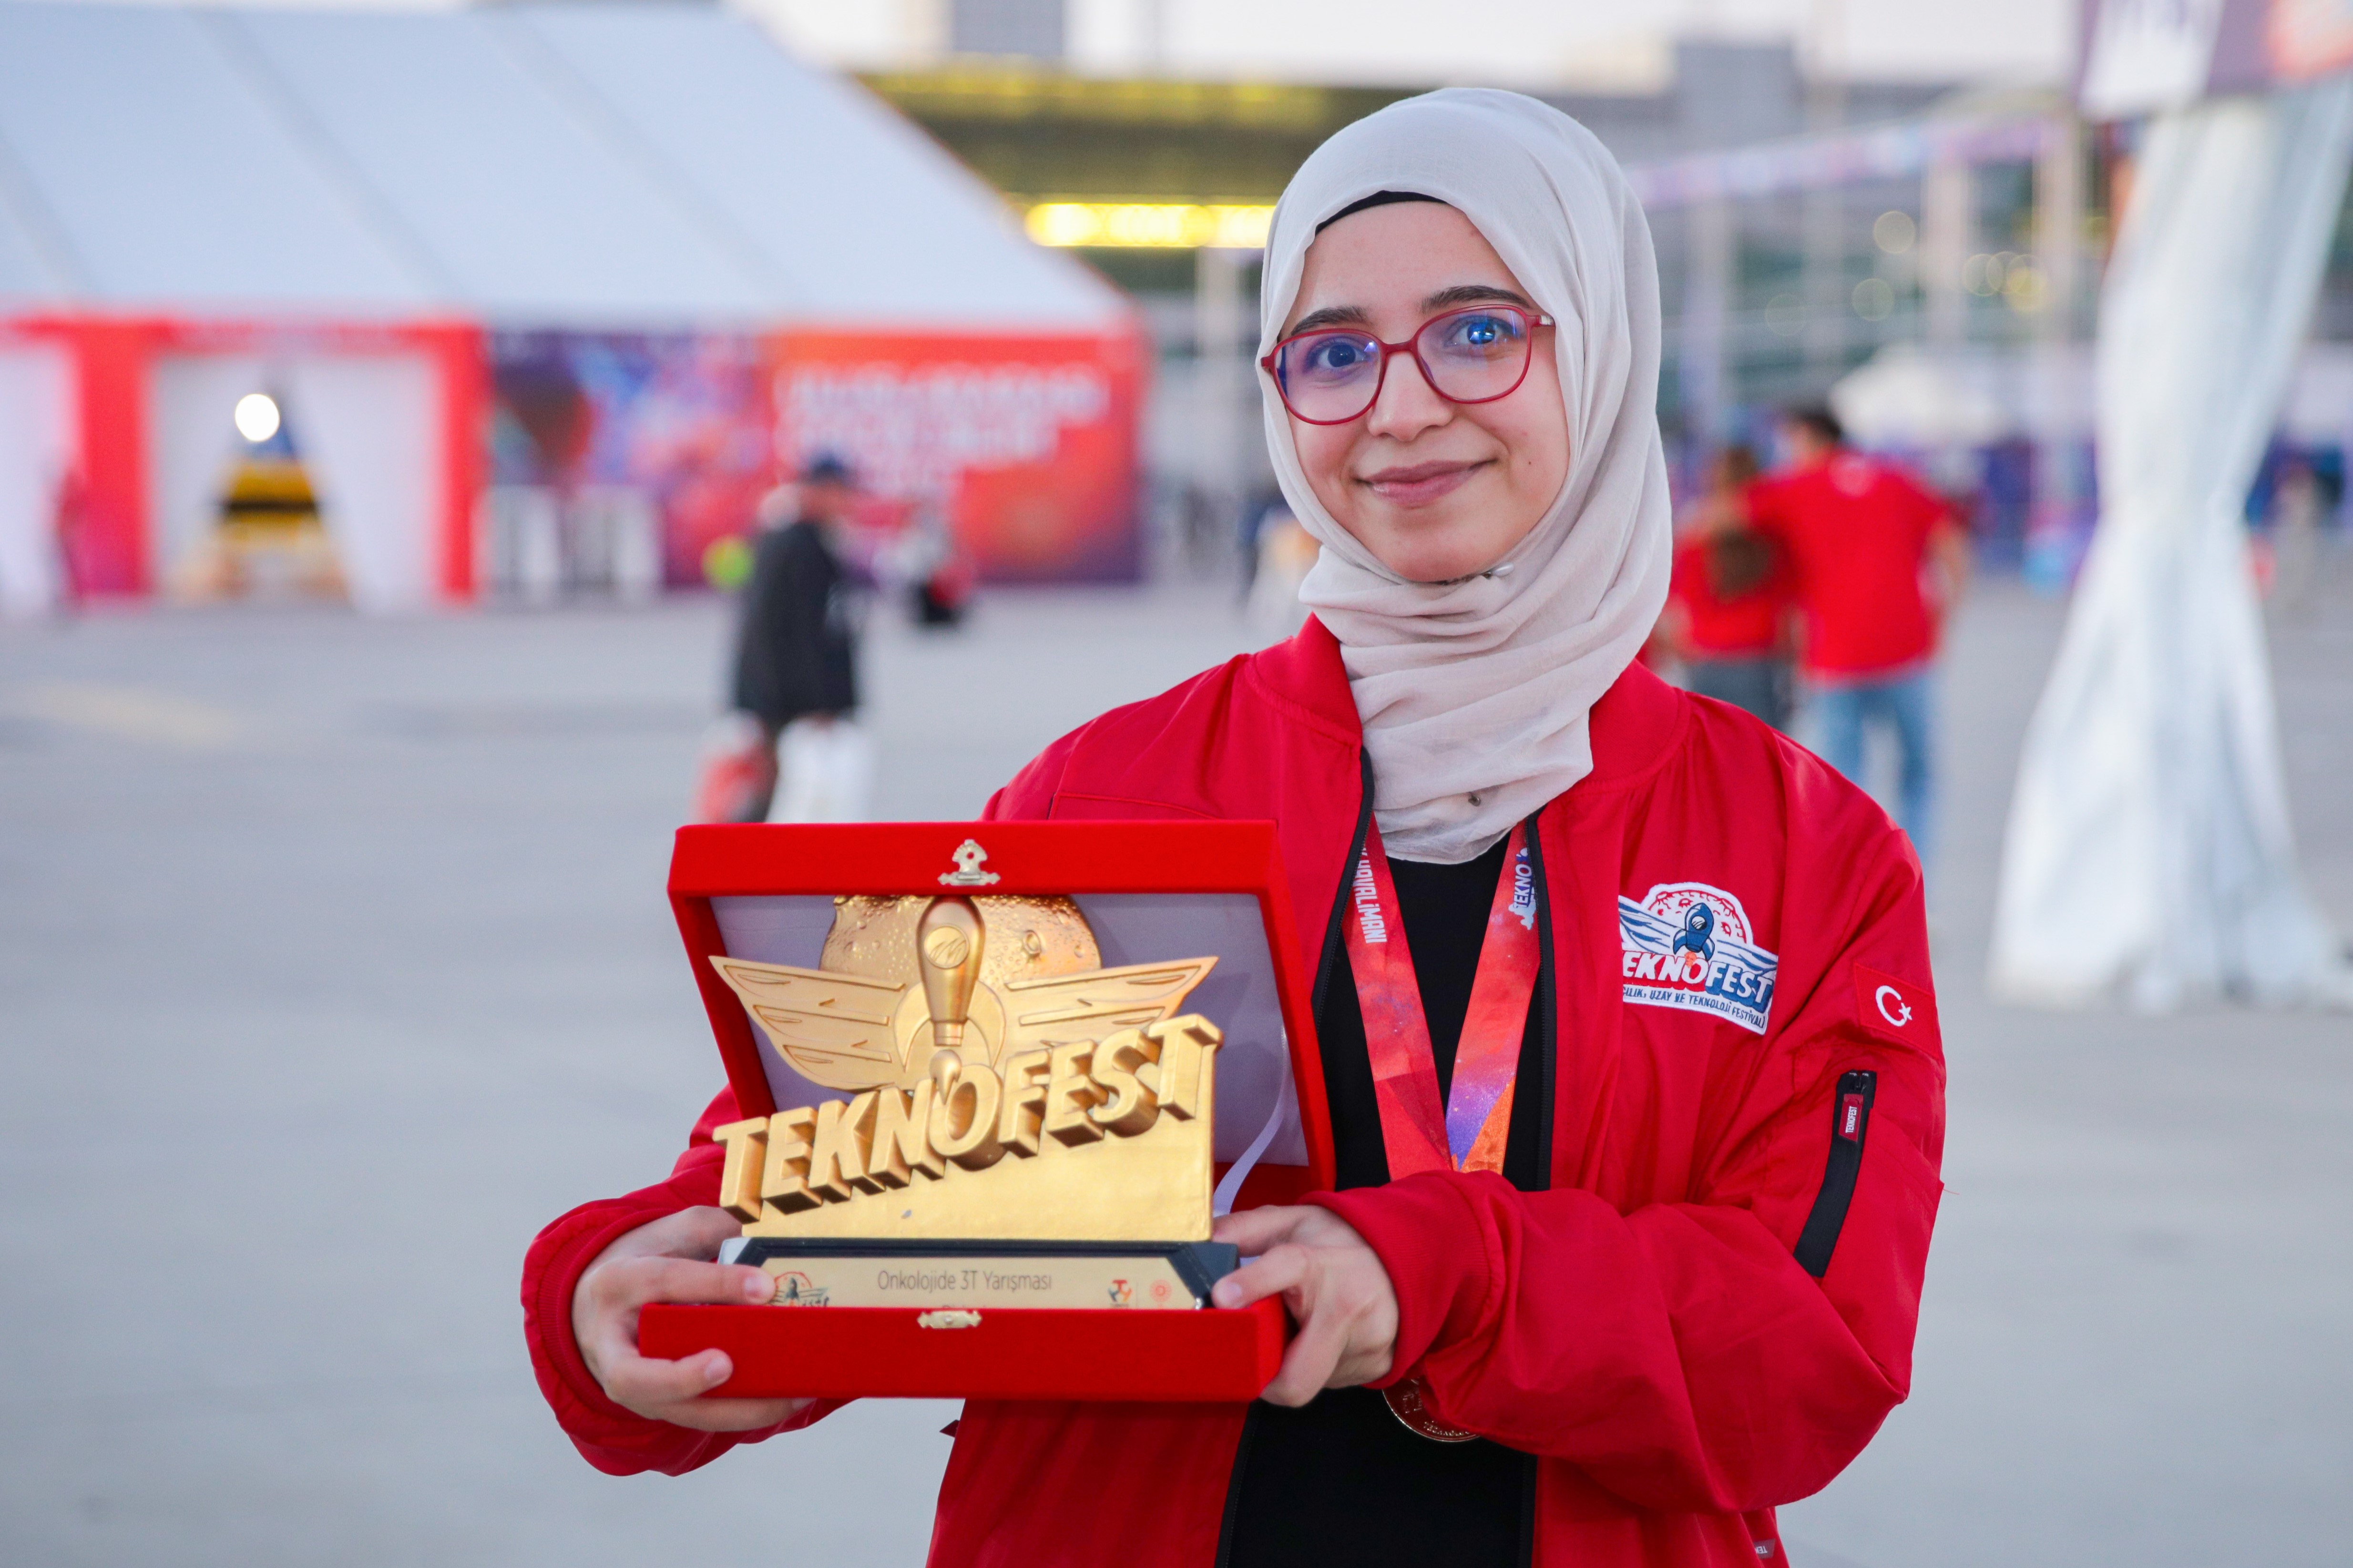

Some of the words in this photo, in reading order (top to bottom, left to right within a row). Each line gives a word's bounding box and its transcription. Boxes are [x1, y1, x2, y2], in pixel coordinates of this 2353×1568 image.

[1514, 864, 1532, 908] TEKNO
[1623, 951, 1773, 1004] EKNOFEST
[1649, 990, 1672, 1001] UZAY
[1674, 993, 1686, 1003] VE
[712, 1014, 1223, 1224] TEKNOFEST
[1845, 1106, 1857, 1133] TEKNOFEST
[878, 1270, 956, 1293] Onkolojide
[961, 1270, 978, 1290] 3T
[983, 1271, 1052, 1292] Yarışması
